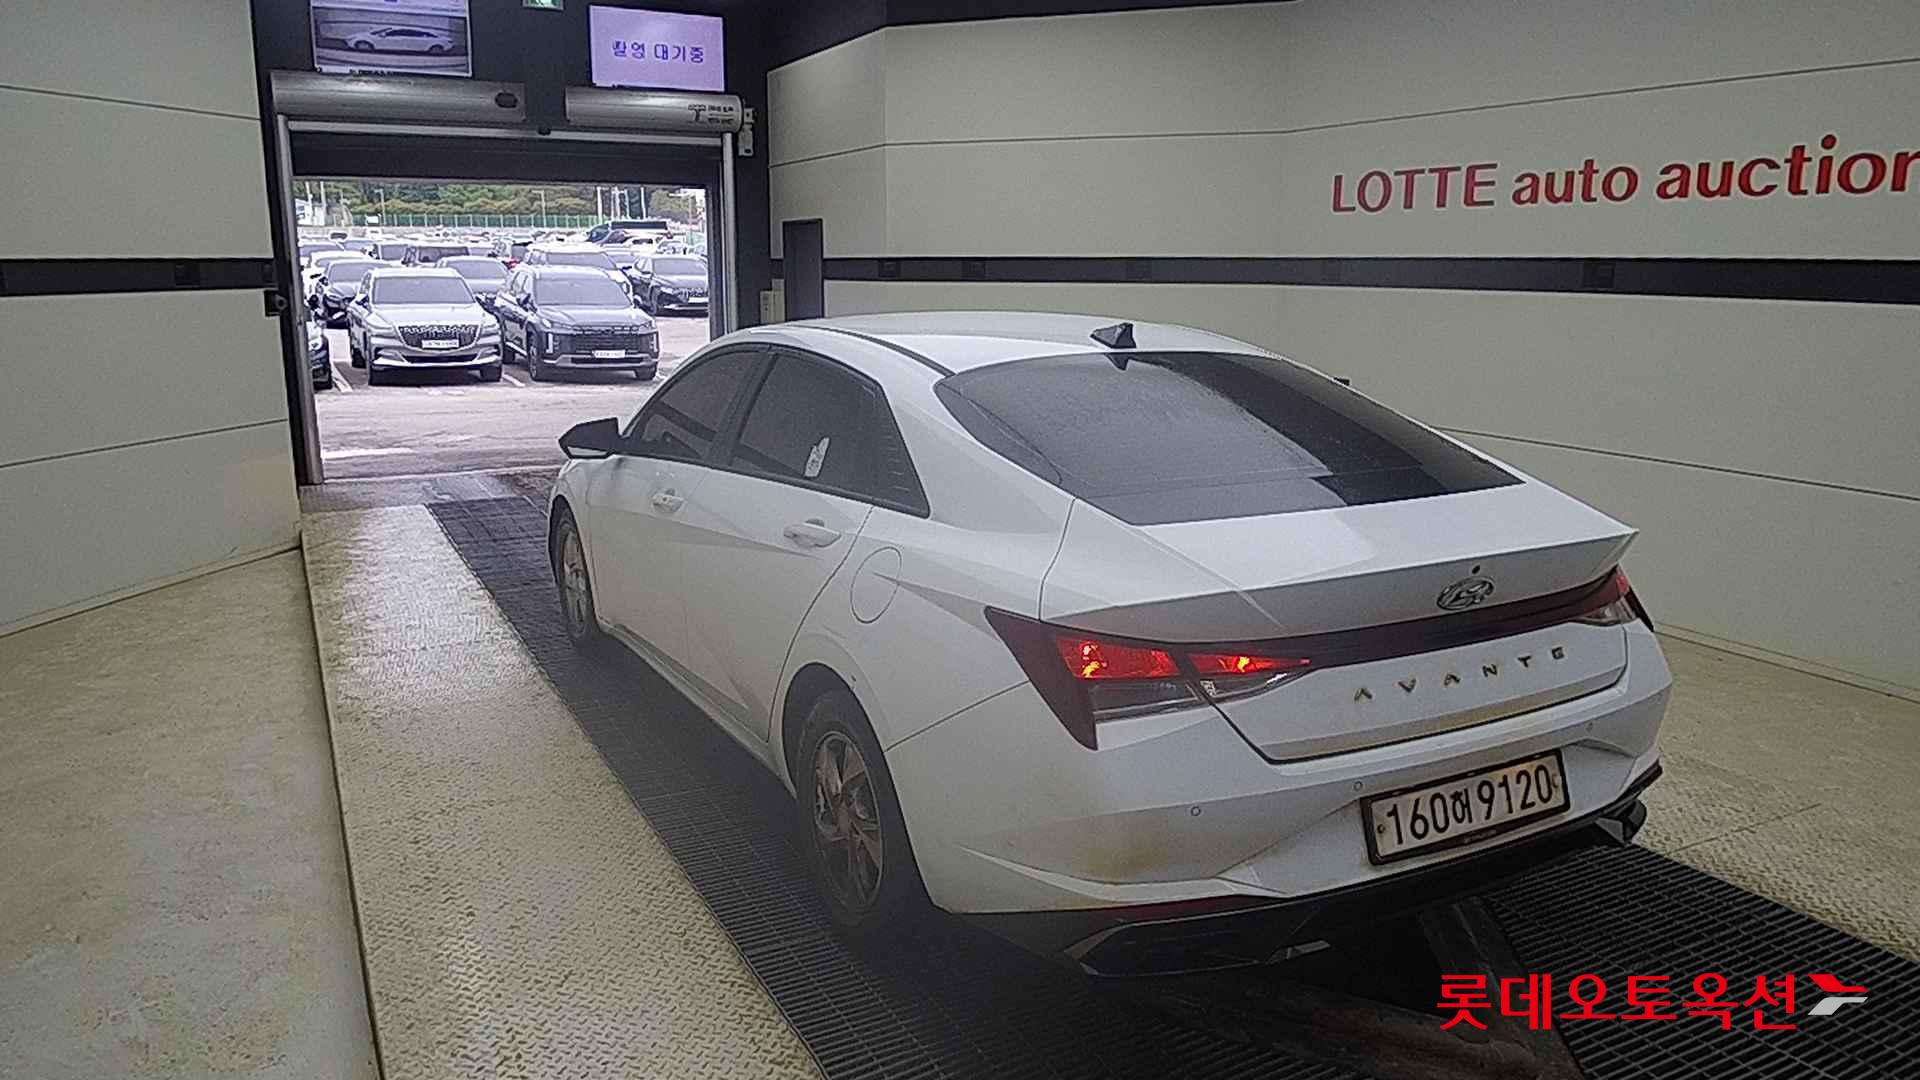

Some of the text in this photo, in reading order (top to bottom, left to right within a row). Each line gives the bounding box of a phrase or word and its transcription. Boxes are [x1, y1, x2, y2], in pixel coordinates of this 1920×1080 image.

[654, 43, 704, 63] 대기중
[1332, 162, 1498, 213] LOTTE
[1512, 158, 1638, 205] auto
[1354, 646, 1566, 702] AVANTE
